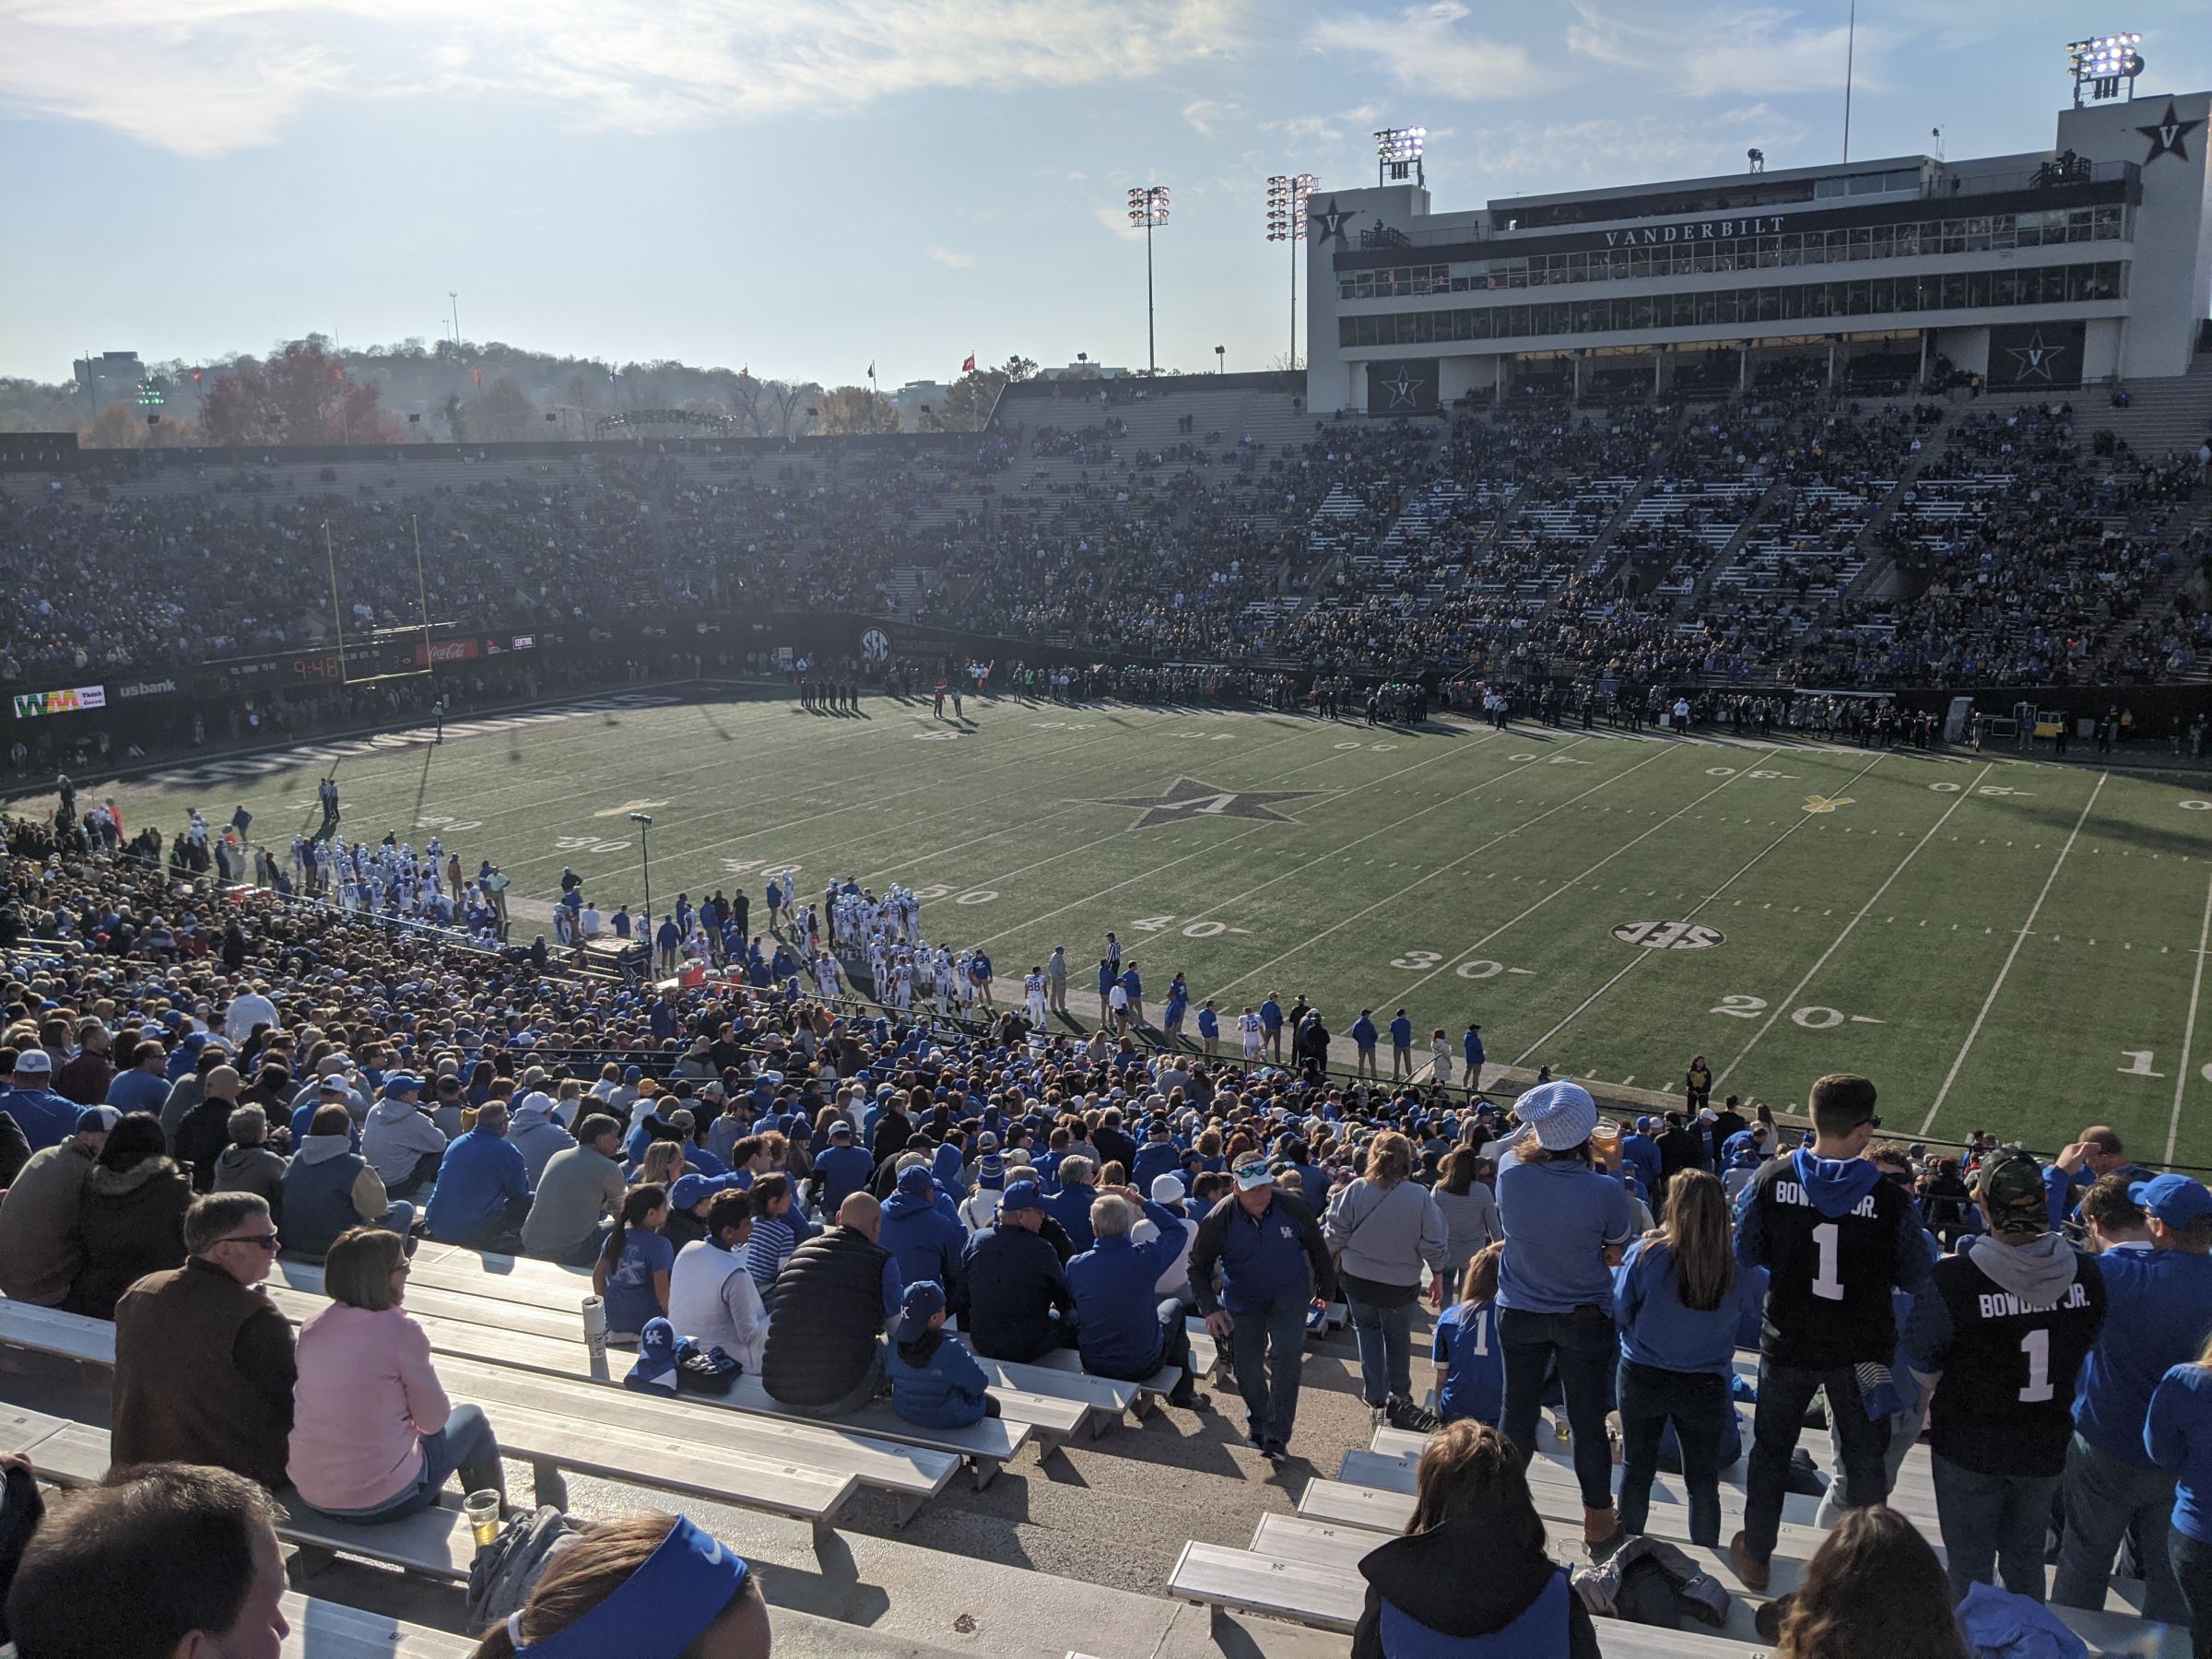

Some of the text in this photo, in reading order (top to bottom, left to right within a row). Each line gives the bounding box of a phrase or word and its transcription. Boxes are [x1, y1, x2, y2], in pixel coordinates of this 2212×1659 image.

[2159, 124, 2180, 148] V
[1326, 214, 1339, 232] V
[1606, 217, 1783, 246] VANDERBILT
[2029, 349, 2043, 366] V
[861, 629, 889, 662] SEC
[919, 953, 931, 964] 34
[1028, 981, 1041, 992] 88
[1245, 1020, 1258, 1032] 12
[1811, 1222, 1844, 1300] 1
[646, 1329, 664, 1346] UK
[1474, 1310, 1488, 1357] 1
[2018, 1328, 2054, 1403] 1
[1323, 1529, 1335, 1537] 24
[1272, 1562, 1286, 1571] 24
